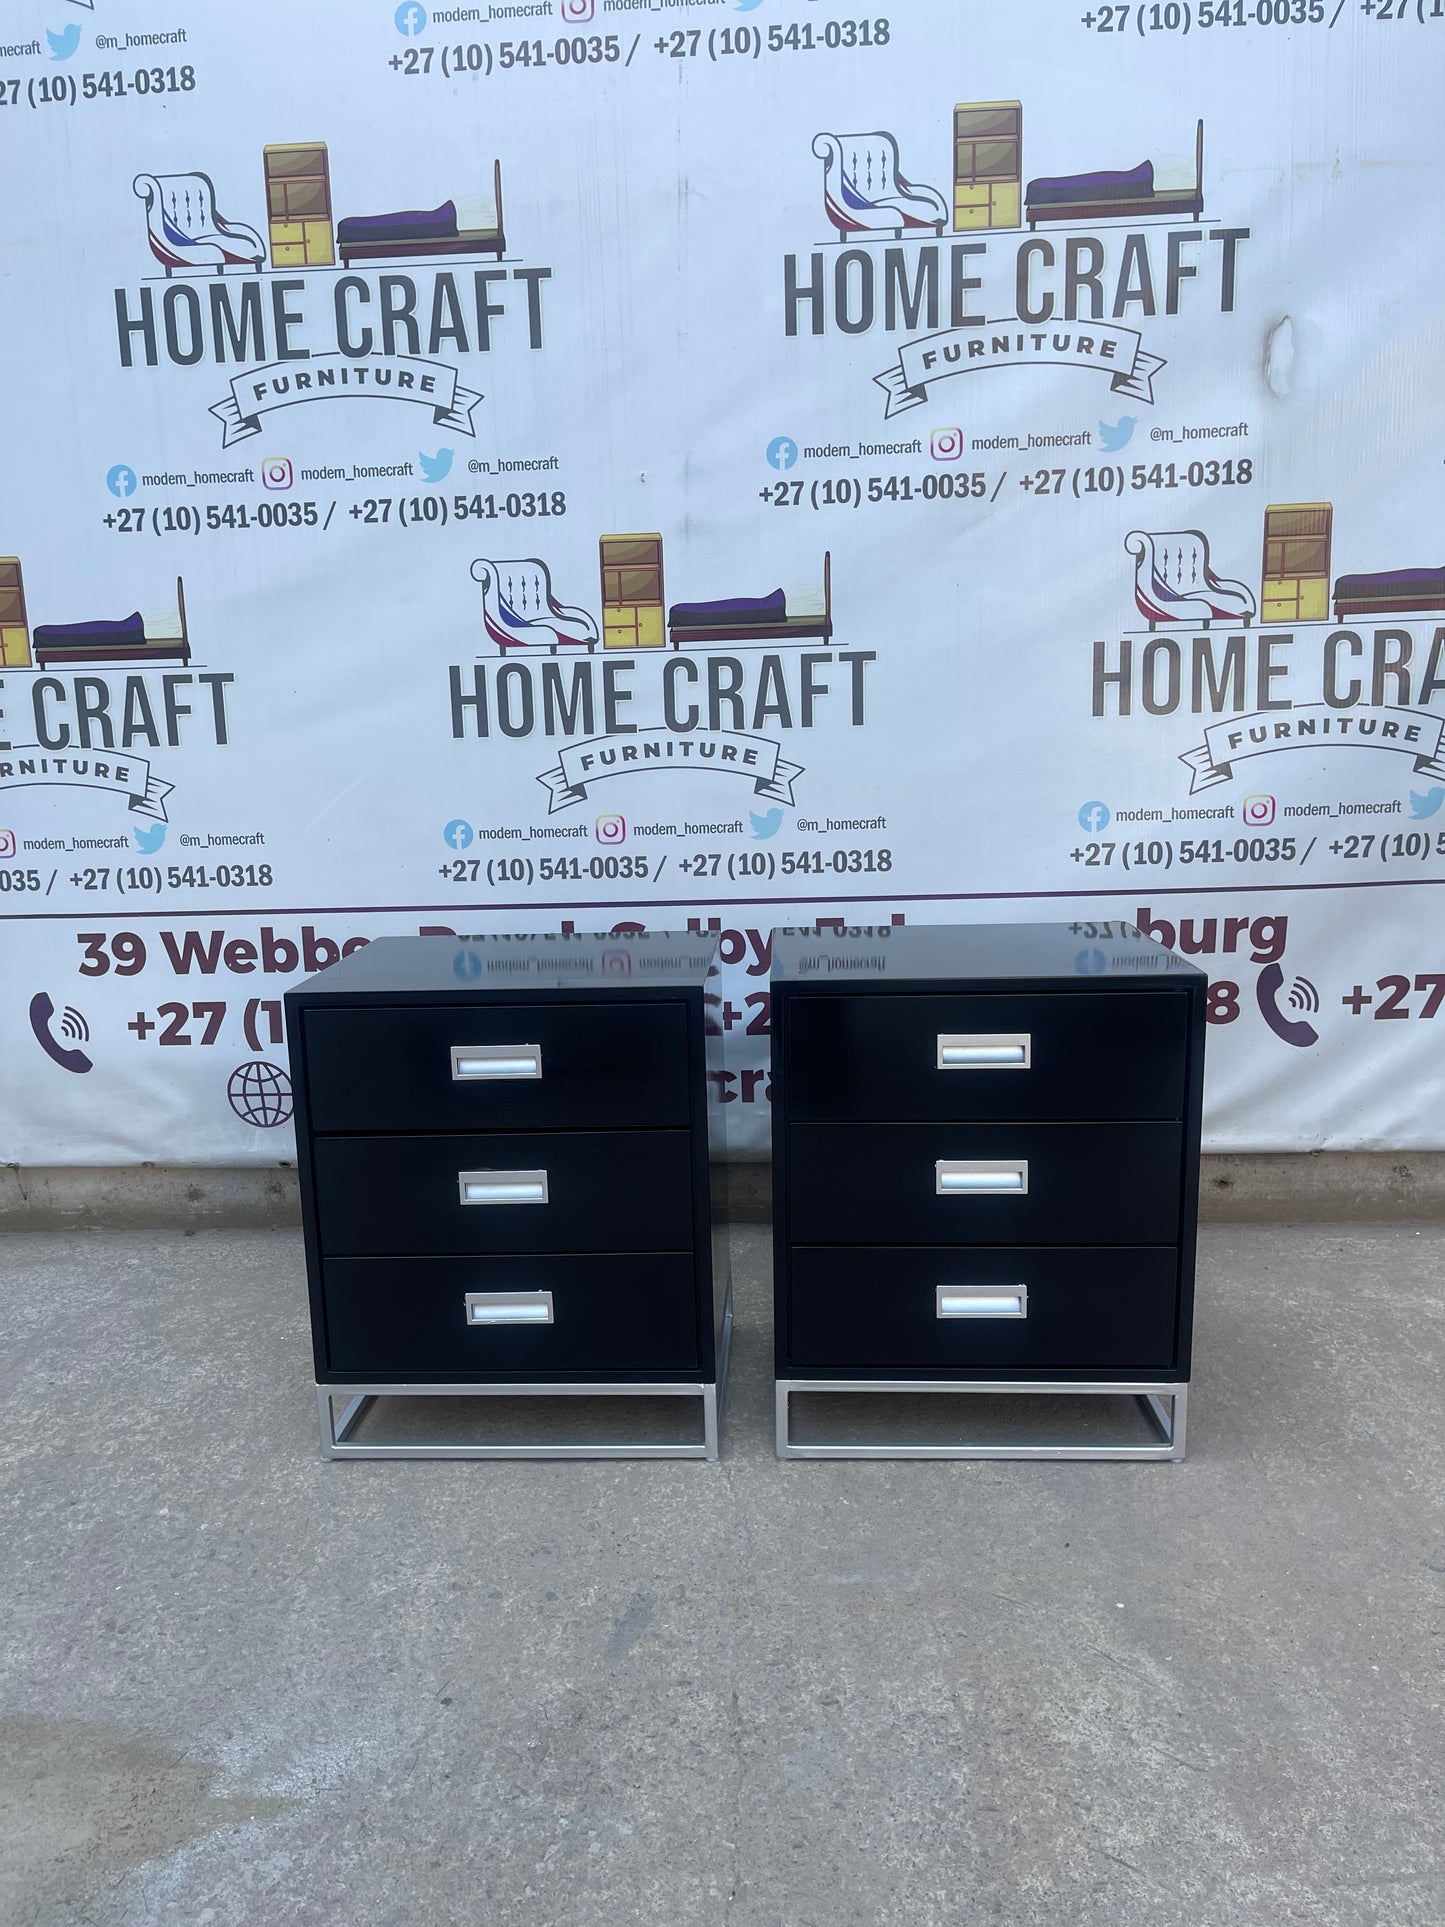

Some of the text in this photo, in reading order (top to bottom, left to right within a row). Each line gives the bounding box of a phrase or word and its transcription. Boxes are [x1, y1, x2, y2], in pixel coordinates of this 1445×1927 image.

[1081, 5, 1130, 32] +27
[1198, 0, 1324, 28] 541-0035
[96, 28, 187, 50] @m_homecraft
[389, 48, 434, 74] +27
[500, 35, 620, 68] 541-0035
[654, 30, 701, 57] +27
[768, 19, 890, 51] 541-0318
[83, 65, 195, 98] 541-0318
[784, 228, 1250, 336] HOME CRAFT
[115, 268, 552, 367] HOME CRAFT
[922, 334, 1117, 370] FURNITURE
[253, 368, 435, 401] FURNITURE
[1151, 422, 1248, 443] @m_homecraft
[468, 456, 559, 475] @m_homecraft
[759, 481, 804, 506] +27
[868, 473, 986, 502] 541-0035
[1020, 469, 1066, 494] +27
[1131, 459, 1252, 489] 541-0318
[103, 508, 145, 532] +27
[207, 502, 318, 529] 541-0035
[349, 499, 392, 523] +27
[454, 492, 566, 520] 541-0318
[1092, 634, 1293, 716] HOME
[449, 651, 876, 738] HOME CRAFT
[32, 673, 234, 750] CRAFT
[1228, 718, 1421, 749] FURNITURE
[581, 742, 758, 771] FURNITURE
[180, 832, 265, 848] @m_homecraft
[797, 816, 886, 833] @m_homecraft
[439, 860, 480, 881] +27
[540, 856, 648, 880] 541-0035
[679, 854, 721, 876] +27
[782, 849, 892, 874] 541-0318
[1070, 843, 1115, 866] +27
[1179, 838, 1296, 863] 541-0035
[1329, 835, 1375, 858] +27
[70, 868, 110, 890] +27
[168, 864, 273, 888] 541-0318
[77, 932, 146, 976] 39
[128, 1002, 226, 1045] +27
